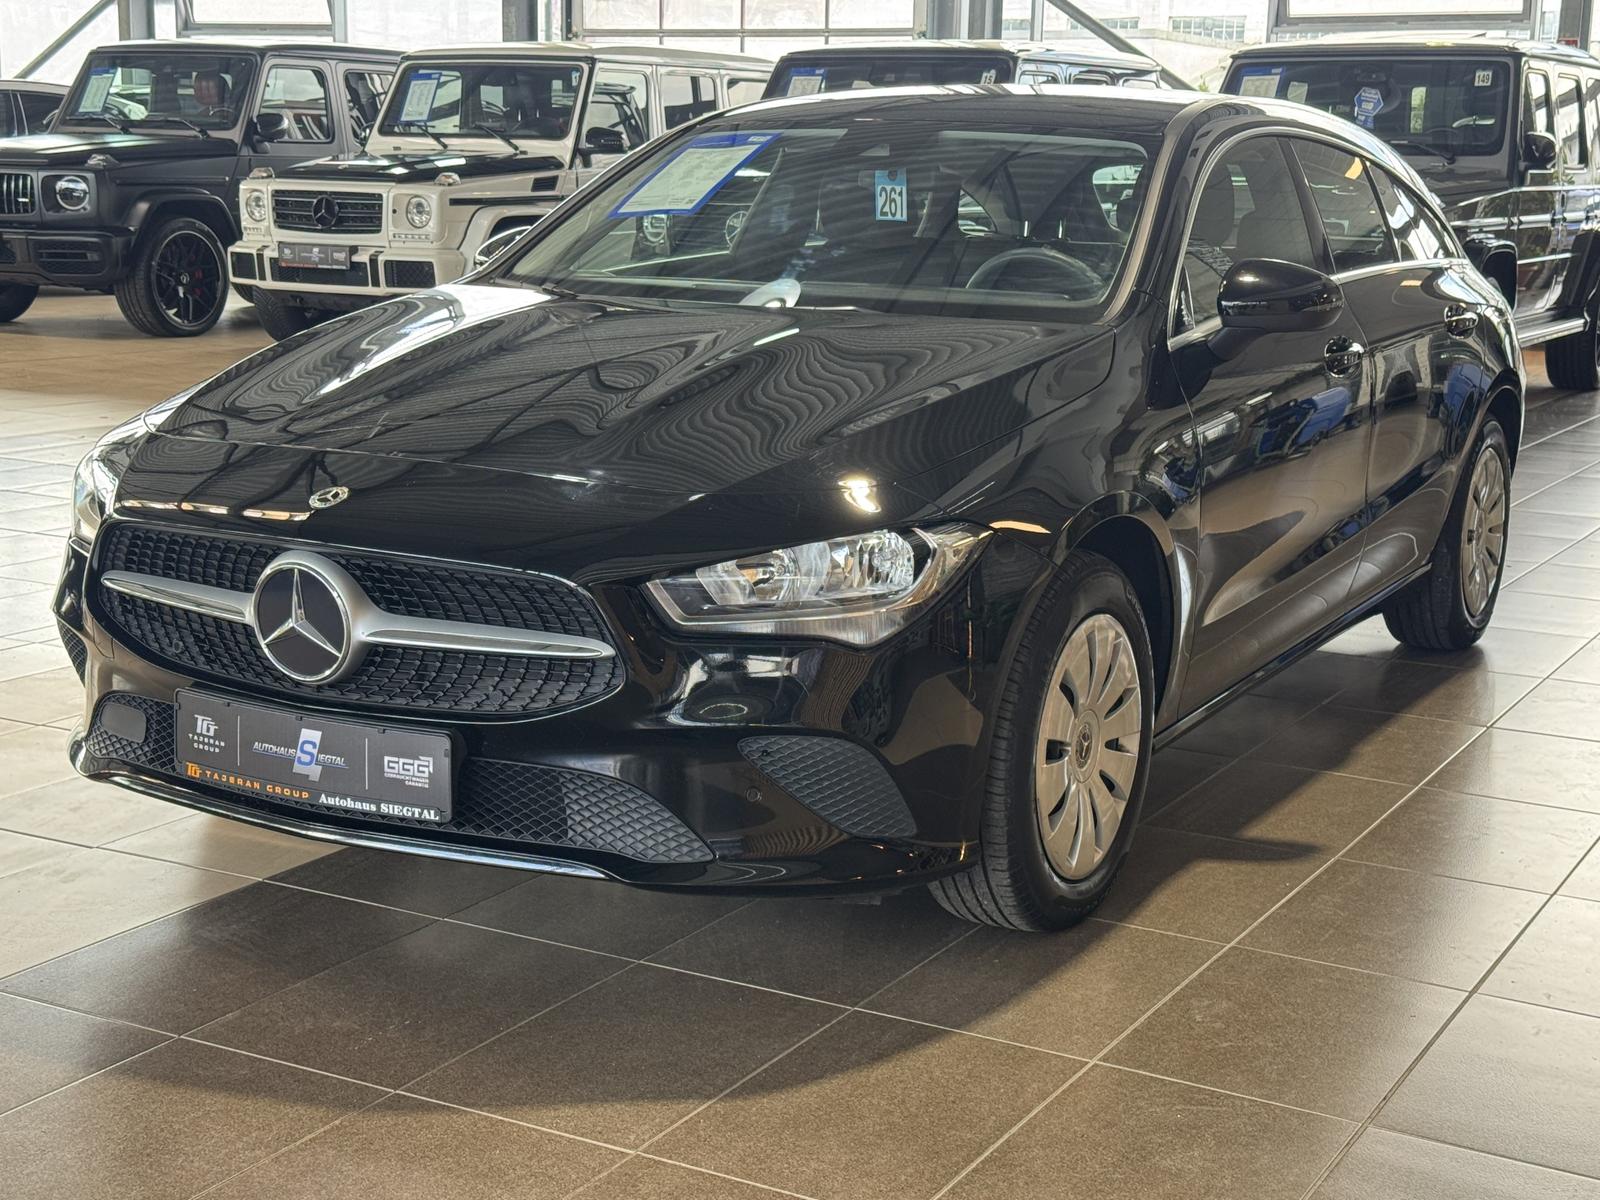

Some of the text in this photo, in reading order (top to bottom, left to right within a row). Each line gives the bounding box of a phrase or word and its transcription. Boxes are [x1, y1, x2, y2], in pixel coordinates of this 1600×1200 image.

[1476, 72, 1490, 84] 149
[879, 186, 904, 218] 261
[193, 742, 220, 753] GROUP
[253, 741, 297, 757] AUTOHAUS
[383, 755, 433, 778] GGG
[266, 785, 310, 799] GROUP
[319, 793, 440, 820] Autohaus SIEGTAL
